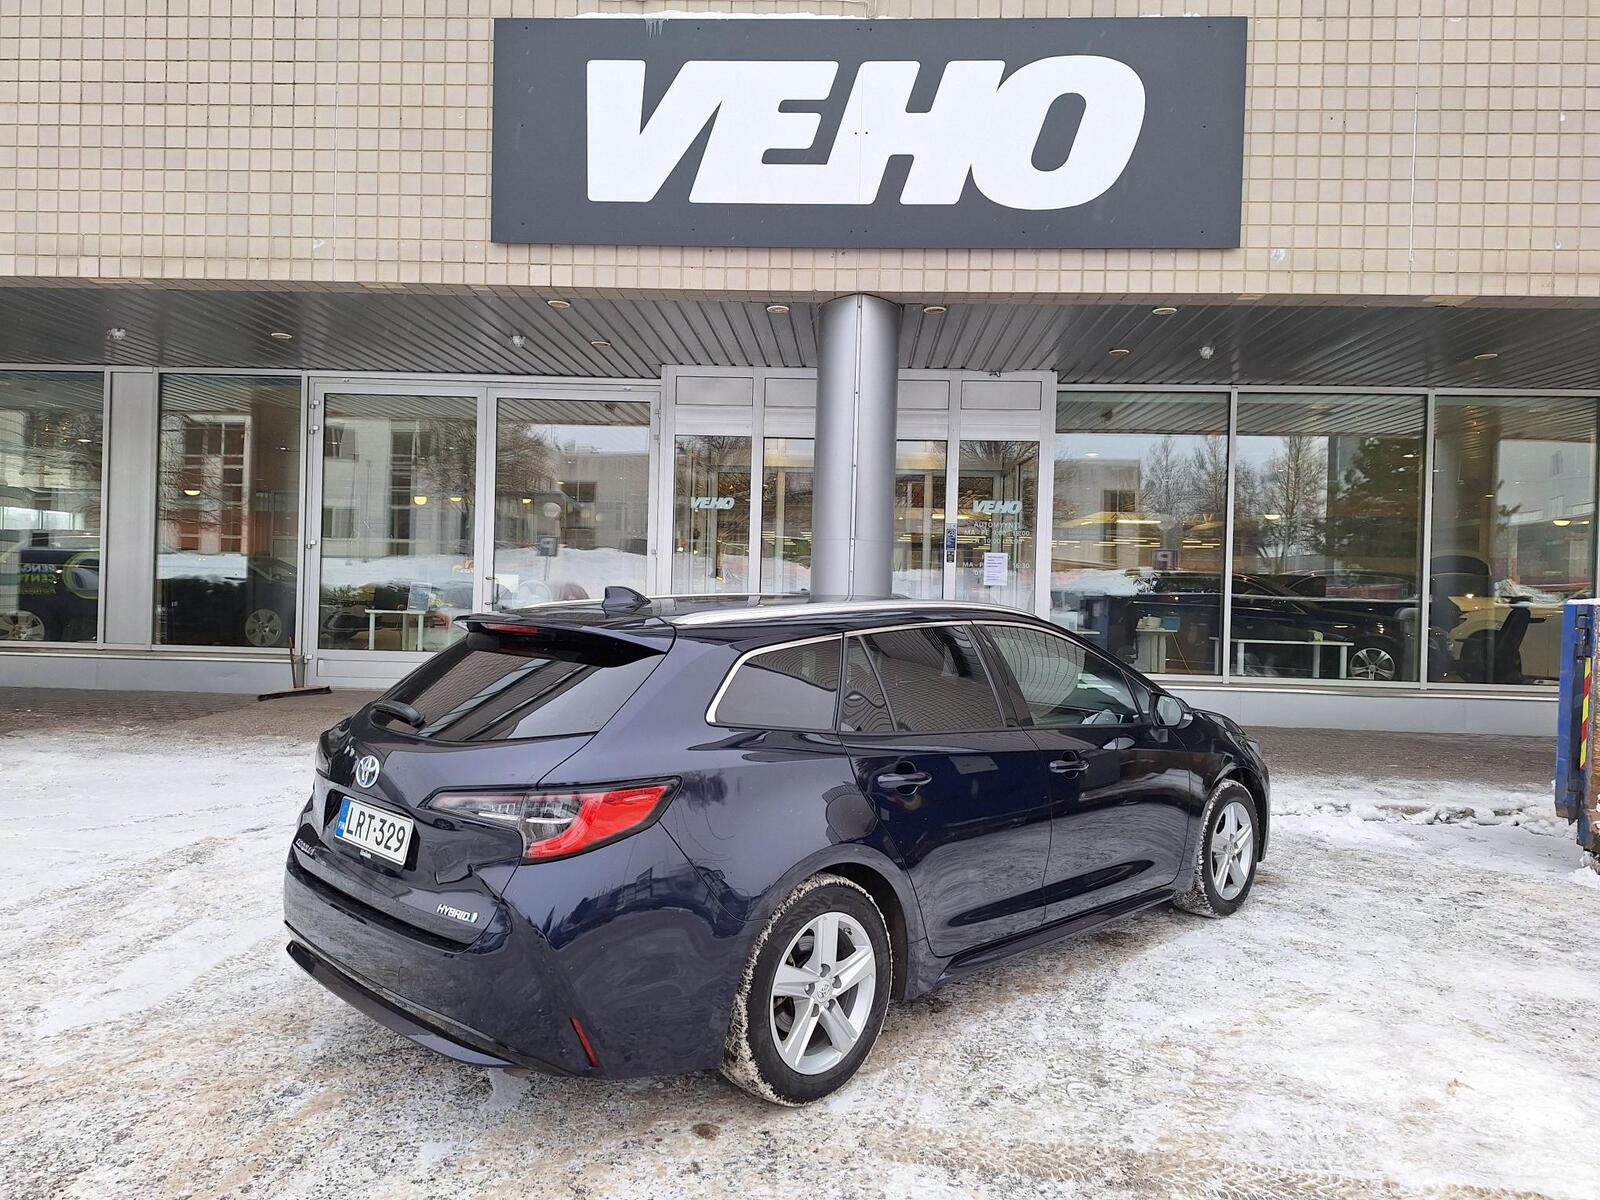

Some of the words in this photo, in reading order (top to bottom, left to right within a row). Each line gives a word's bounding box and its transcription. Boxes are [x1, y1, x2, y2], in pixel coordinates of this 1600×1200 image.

[586, 55, 1147, 211] VEHO
[691, 496, 735, 509] VEHO
[973, 501, 1022, 513] VEHO
[974, 521, 1020, 529] AUTOMYYNTI
[346, 807, 406, 853] LRT-329
[436, 903, 471, 922] HYBRID
